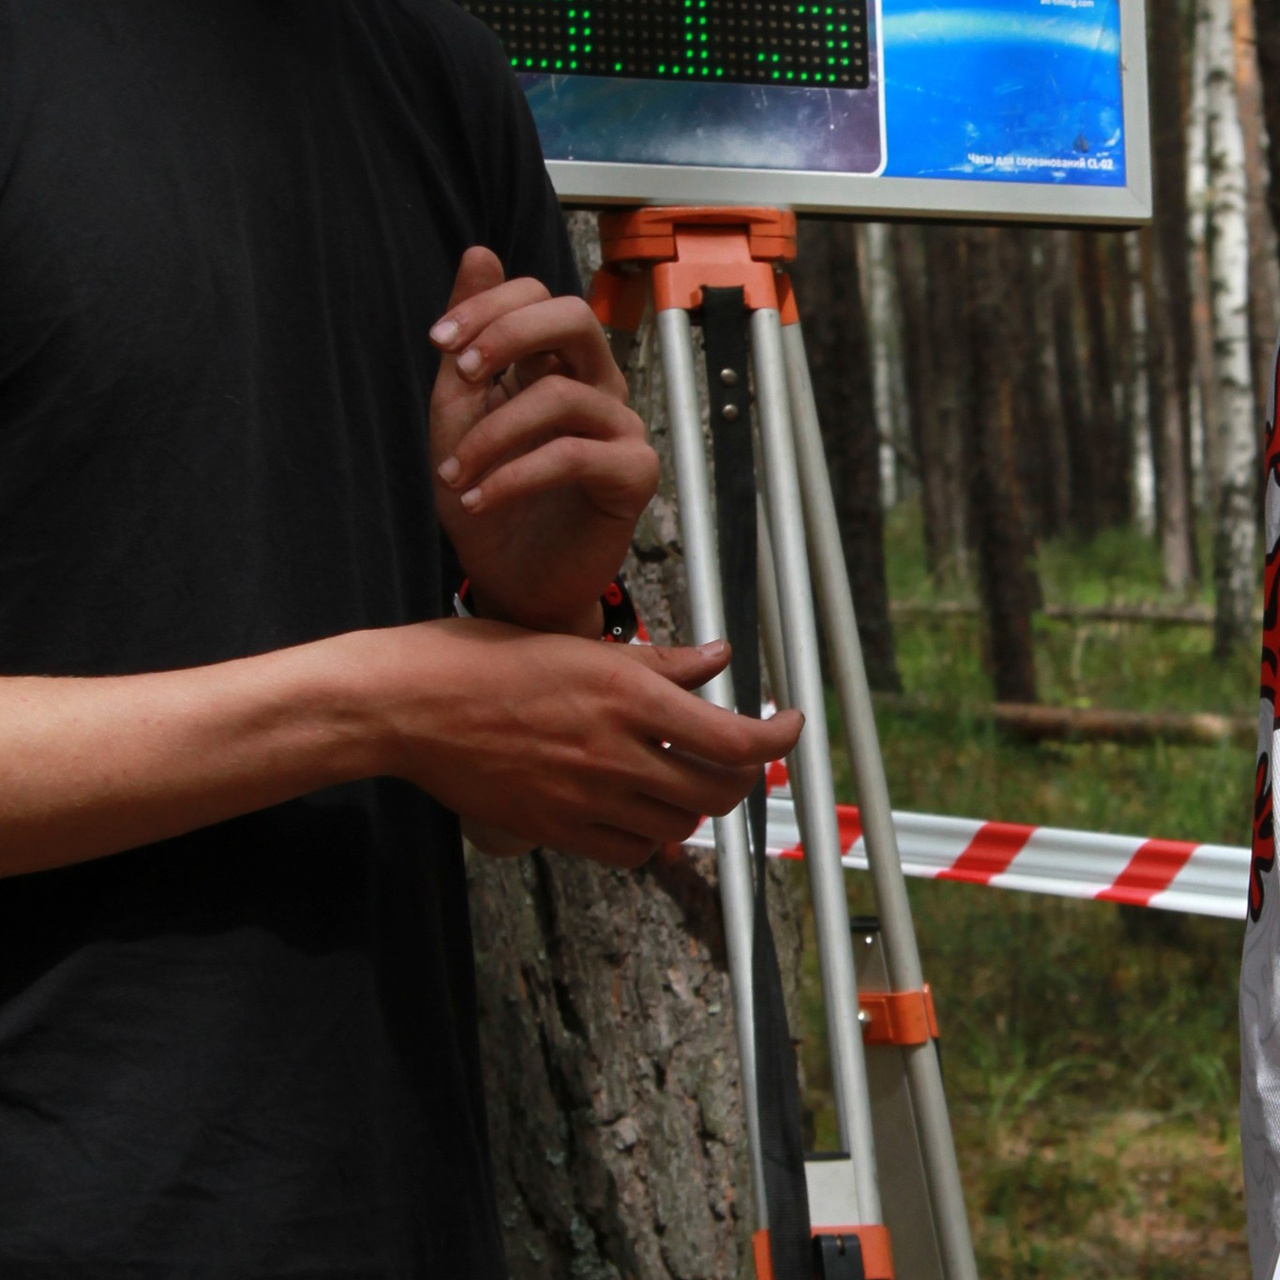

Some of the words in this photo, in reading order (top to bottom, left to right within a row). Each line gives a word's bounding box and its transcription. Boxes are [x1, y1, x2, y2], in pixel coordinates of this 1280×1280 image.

[967, 152, 994, 165] Часы
[995, 156, 1014, 167] для
[1016, 157, 1086, 169] соревнований
[1087, 158, 1114, 170] CL-02
